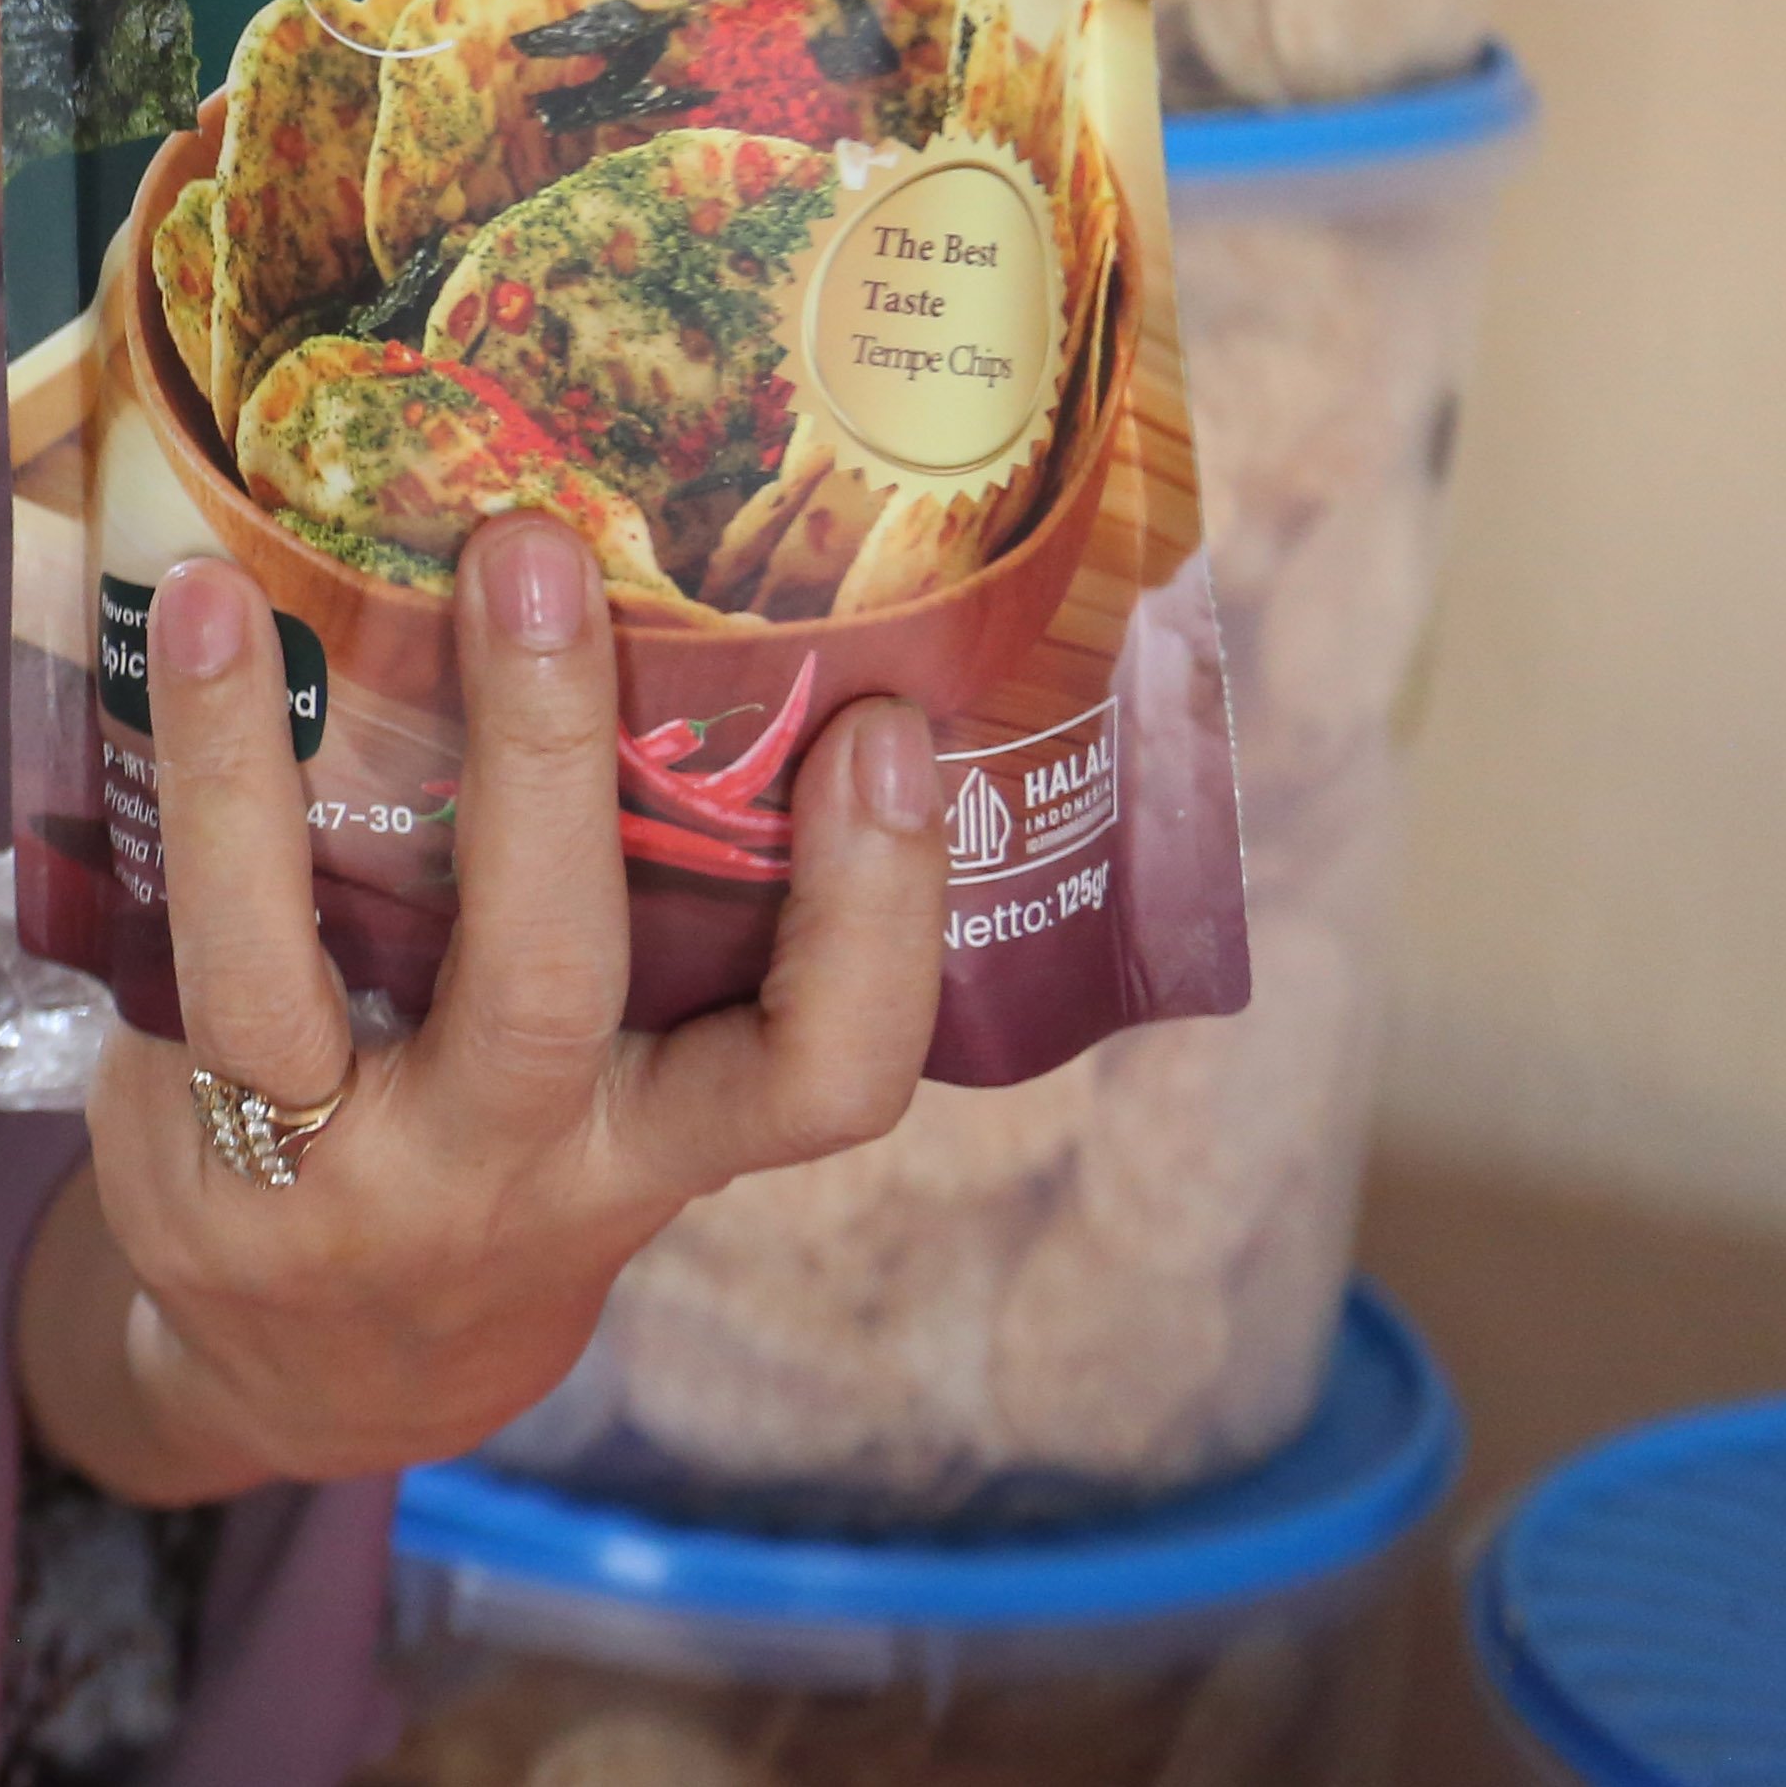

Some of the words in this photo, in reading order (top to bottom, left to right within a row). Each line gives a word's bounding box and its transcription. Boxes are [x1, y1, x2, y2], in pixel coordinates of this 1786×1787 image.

[874, 226, 936, 260] The
[943, 233, 998, 267] Best
[863, 280, 946, 318] Taste
[851, 334, 943, 381] Tempe
[949, 344, 1014, 388] Chips
[102, 633, 146, 681] Spic
[1025, 736, 1112, 809] HALAL
[104, 780, 158, 829] Produc
[307, 801, 414, 834] 47-30
[1025, 777, 1112, 835] INDONESIA
[1056, 859, 1110, 920] 125gr
